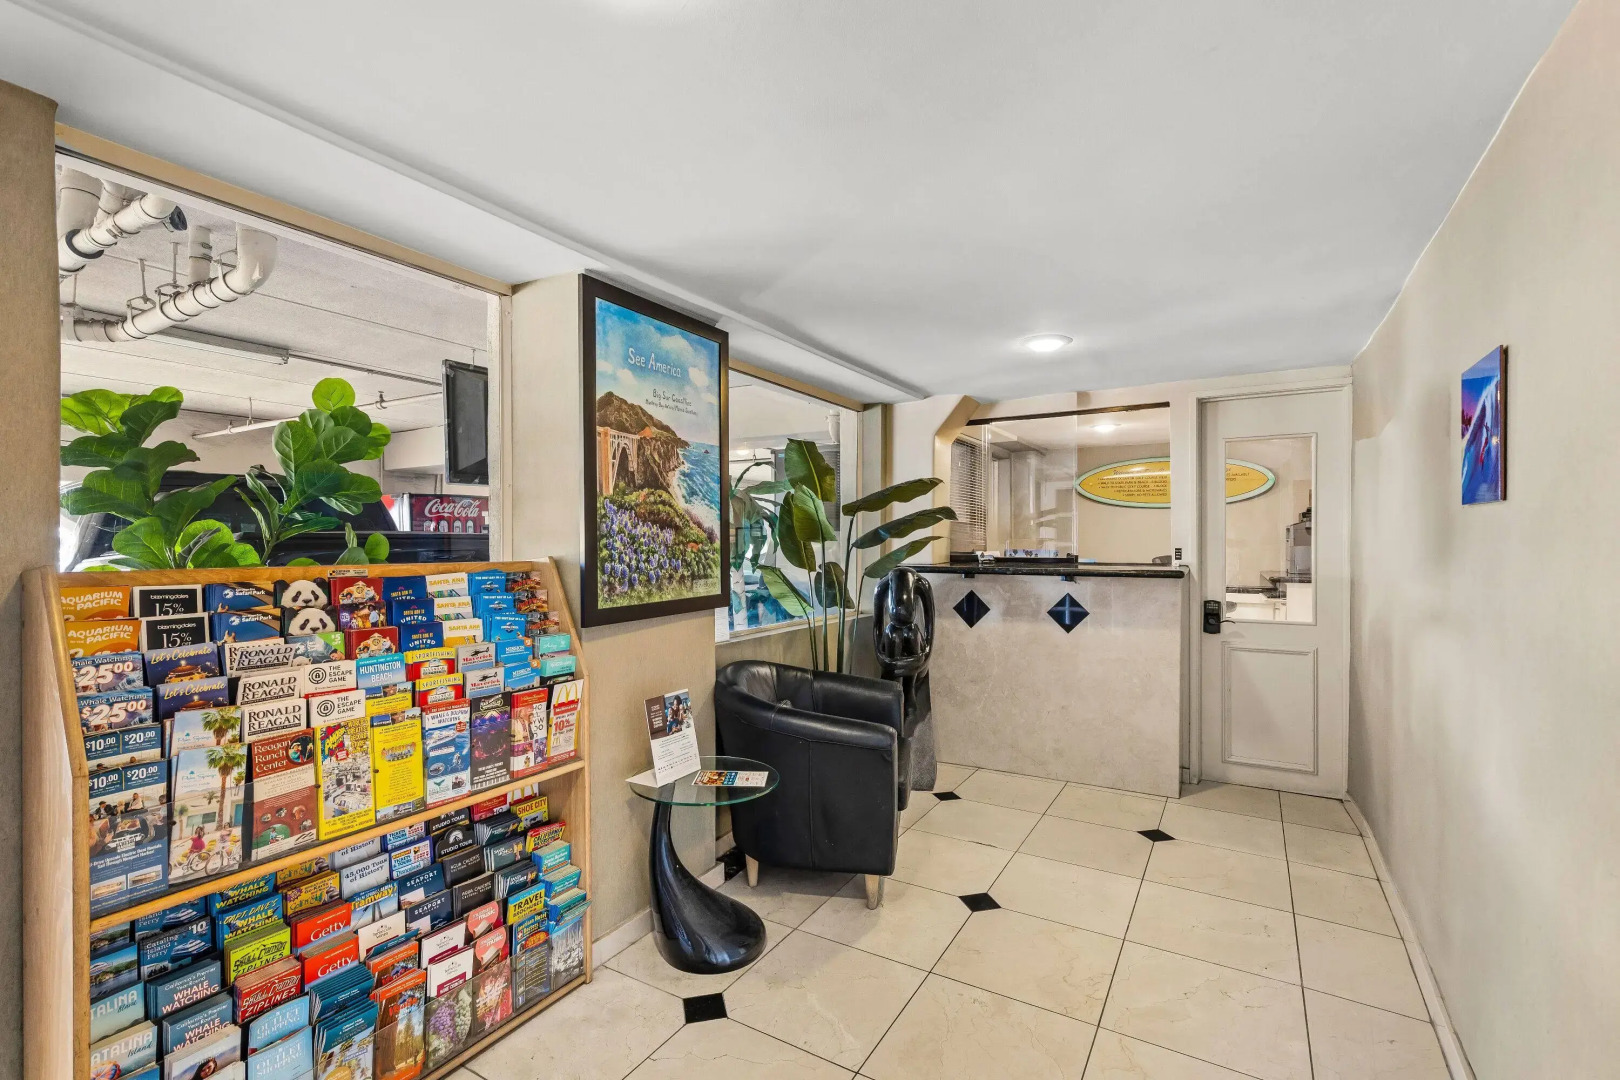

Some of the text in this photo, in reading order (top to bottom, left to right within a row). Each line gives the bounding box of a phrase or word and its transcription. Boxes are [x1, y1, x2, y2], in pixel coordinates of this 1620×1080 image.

[628, 347, 682, 378] See America
[652, 388, 661, 400] Big
[662, 390, 670, 401] Sur
[429, 578, 450, 586] SANTA
[60, 590, 123, 604] AQUARIUM
[76, 599, 122, 610] PACIFIC
[154, 602, 185, 616] 15%
[400, 615, 427, 624] UNITED
[68, 624, 134, 639] AQUARIUM
[86, 632, 132, 644] PACIFIC
[162, 632, 192, 648] 15%
[409, 639, 436, 648] UNITED
[96, 655, 133, 666] Watching
[151, 646, 212, 664] Let's Celebrate
[238, 654, 291, 666] REAGAN
[240, 646, 293, 660] RONALD
[415, 650, 453, 659] SPORTFISHING
[462, 654, 493, 662] Maverick
[360, 661, 401, 674] HUNTINGTON
[242, 676, 297, 694] RONALD
[371, 672, 393, 682] BEACH
[422, 676, 460, 688] SPORTFISHING
[471, 680, 500, 688] Maverick
[164, 680, 226, 700] Let's Celebrate
[242, 685, 296, 700] REAGAN
[80, 693, 147, 706] Whale Watching
[338, 699, 362, 708] ESCAPE
[248, 704, 302, 722] RONALD
[248, 713, 302, 731] REAGAN
[554, 719, 570, 732] 10%
[86, 730, 156, 752] $10.00 $20.00
[254, 740, 291, 754] Reagan
[255, 750, 286, 764] Ranch
[256, 760, 288, 772] Center
[89, 766, 158, 790] $10.00 $20.00
[518, 798, 547, 815] SHOE CITY
[432, 814, 466, 831] STUDIO TOUR
[350, 838, 376, 852] History
[441, 839, 473, 856] STUDIO TOUR
[344, 864, 370, 879] 45,000
[360, 864, 384, 879] History
[406, 870, 437, 887] SEAPORT
[230, 880, 266, 897] WHALE
[216, 886, 269, 909] WATCHING
[351, 886, 394, 911] Tramway
[513, 892, 544, 912] TRAVEL
[414, 898, 445, 915] SEAPORT
[512, 901, 543, 918] BROCHURES
[139, 918, 160, 928] Ferry
[225, 915, 279, 938] WATCHING
[237, 909, 274, 928] WHALE
[189, 920, 207, 934] $10
[310, 918, 346, 942] Getty
[147, 942, 171, 955] Island
[147, 950, 168, 960] Ferry
[317, 954, 354, 978] Getty
[164, 967, 217, 990] California's Premier
[173, 980, 209, 1001] WHALE
[90, 990, 138, 1020] TALINA
[162, 984, 220, 1014] WATCHING
[245, 987, 296, 1017] ZIPLINES
[176, 1004, 228, 1030] California's Premier
[173, 1022, 231, 1051] WATCHING
[185, 1018, 221, 1040] WHALE
[91, 1031, 153, 1065] ATALINA
[128, 1042, 153, 1058] Island
